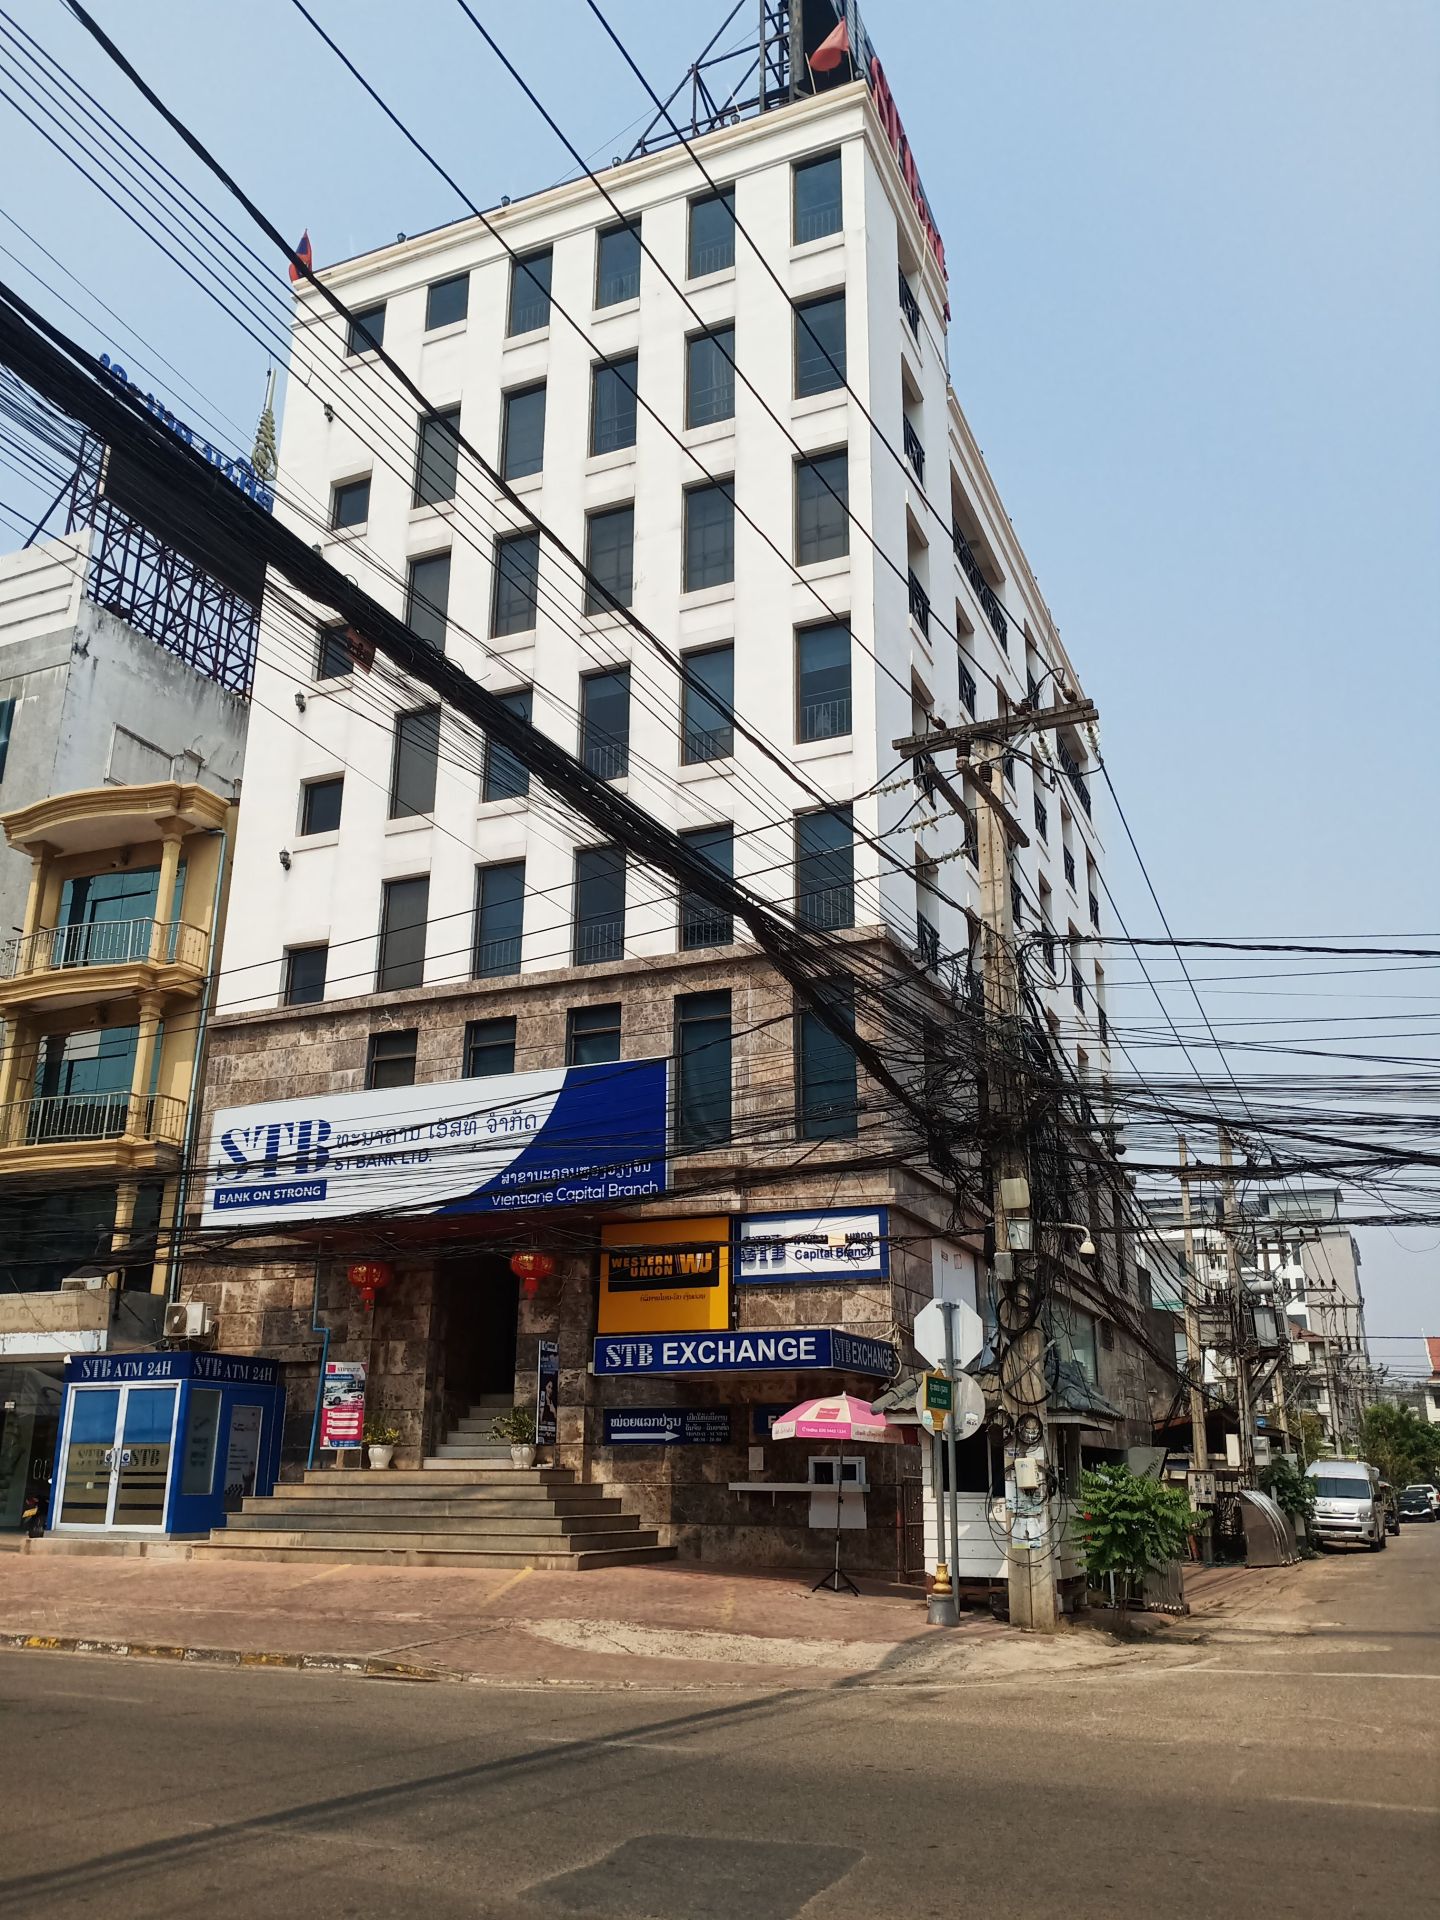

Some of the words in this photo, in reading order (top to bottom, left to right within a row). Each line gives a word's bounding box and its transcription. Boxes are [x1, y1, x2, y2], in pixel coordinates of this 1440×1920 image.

[217, 1119, 332, 1181] STB
[356, 1154, 397, 1168] BANK
[219, 1191, 250, 1204] BANK
[253, 1190, 271, 1202] ON
[274, 1186, 321, 1199] STRONG
[492, 1191, 554, 1206] Vientiane
[556, 1184, 605, 1203] Capital
[608, 1180, 659, 1197] Branch
[611, 1254, 673, 1268] WESTERN
[679, 1252, 712, 1274] WU
[794, 1249, 833, 1262] Capital
[630, 1265, 673, 1277] UNION
[606, 1343, 653, 1367] STB
[663, 1337, 817, 1365] EXCHANGE
[834, 1338, 852, 1363] STB
[852, 1342, 893, 1371] EXCHANGE
[81, 1359, 112, 1378] STB
[114, 1362, 142, 1377] ATM
[147, 1360, 172, 1376] 24H
[193, 1356, 223, 1378] STB
[224, 1362, 249, 1380] ATM
[252, 1366, 273, 1382] 24H
